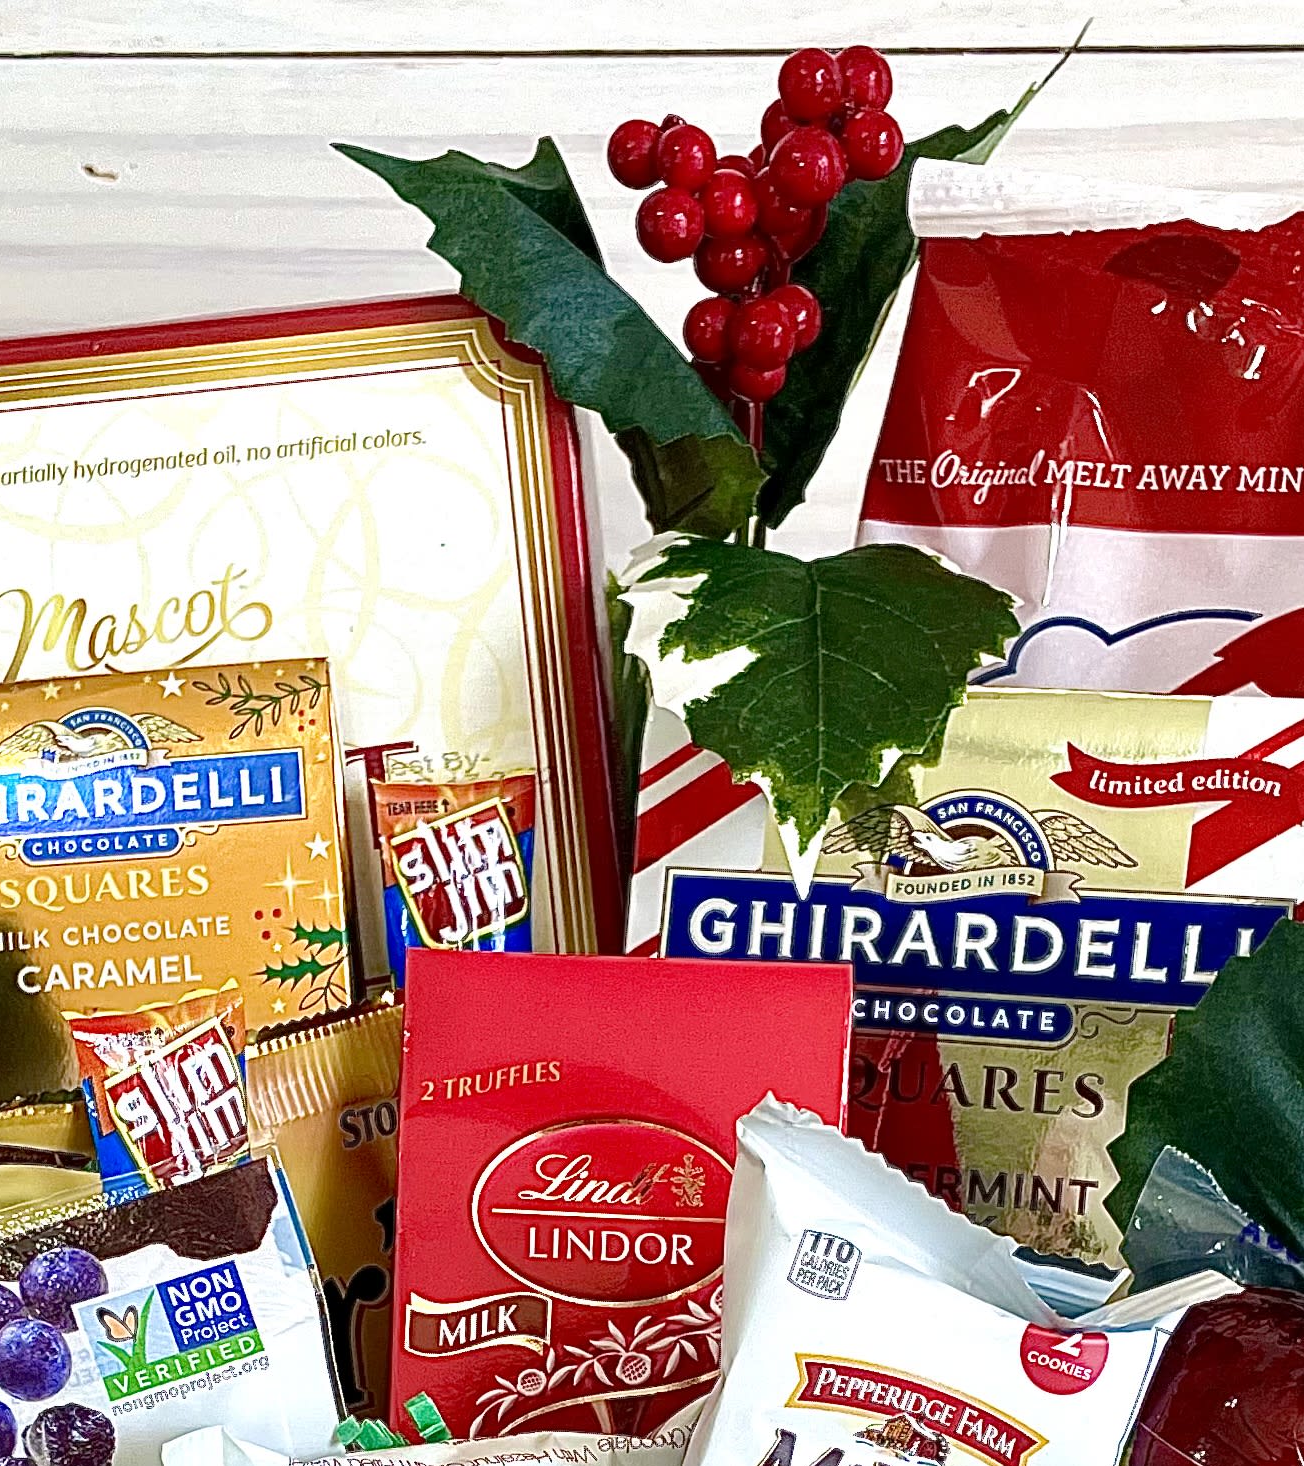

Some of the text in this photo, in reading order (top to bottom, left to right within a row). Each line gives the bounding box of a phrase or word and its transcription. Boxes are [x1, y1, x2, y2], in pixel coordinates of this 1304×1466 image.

[74, 448, 207, 482] hydrogenated
[214, 445, 241, 466] oil,
[247, 446, 271, 462] no
[277, 433, 356, 461] artificial
[363, 429, 427, 450] colors.
[879, 459, 927, 484] THE
[930, 449, 1045, 505] Original
[1044, 460, 1133, 490] MELT
[1135, 464, 1232, 492] AWAY
[70, 713, 145, 749] SAN FRANCISCO
[1088, 768, 1283, 798] limited edition
[387, 799, 440, 816] TEAR HERE
[31, 832, 169, 857] CHOCOLATE
[937, 801, 1043, 864] SAN FRANCISCO
[0, 864, 210, 911] SQUARES
[895, 873, 1036, 896] FOUNDED IN 1852
[63, 915, 231, 946] CHOCOLATE
[17, 955, 202, 994] CARAMEL
[852, 998, 1056, 1033] CHOCOLATE
[420, 1060, 561, 1101] 2 TRUFFLES
[849, 1053, 1105, 1119] QUARES
[339, 1101, 397, 1149] STO
[517, 1153, 670, 1204] Lindt
[528, 1226, 695, 1267] LINDOR
[800, 1251, 850, 1280] CALORIES
[810, 1232, 854, 1263] 110
[167, 1268, 235, 1307] NON
[795, 1267, 844, 1295] PER PACK
[174, 1291, 242, 1327] GMO
[180, 1312, 249, 1345] Project
[438, 1304, 518, 1347] MILK
[113, 1337, 256, 1394] VERIFIED
[1027, 1350, 1092, 1381] COOKIES
[111, 1355, 271, 1416] nongmoproject.org
[814, 1366, 1017, 1460] PEPPERIDGE FARM
